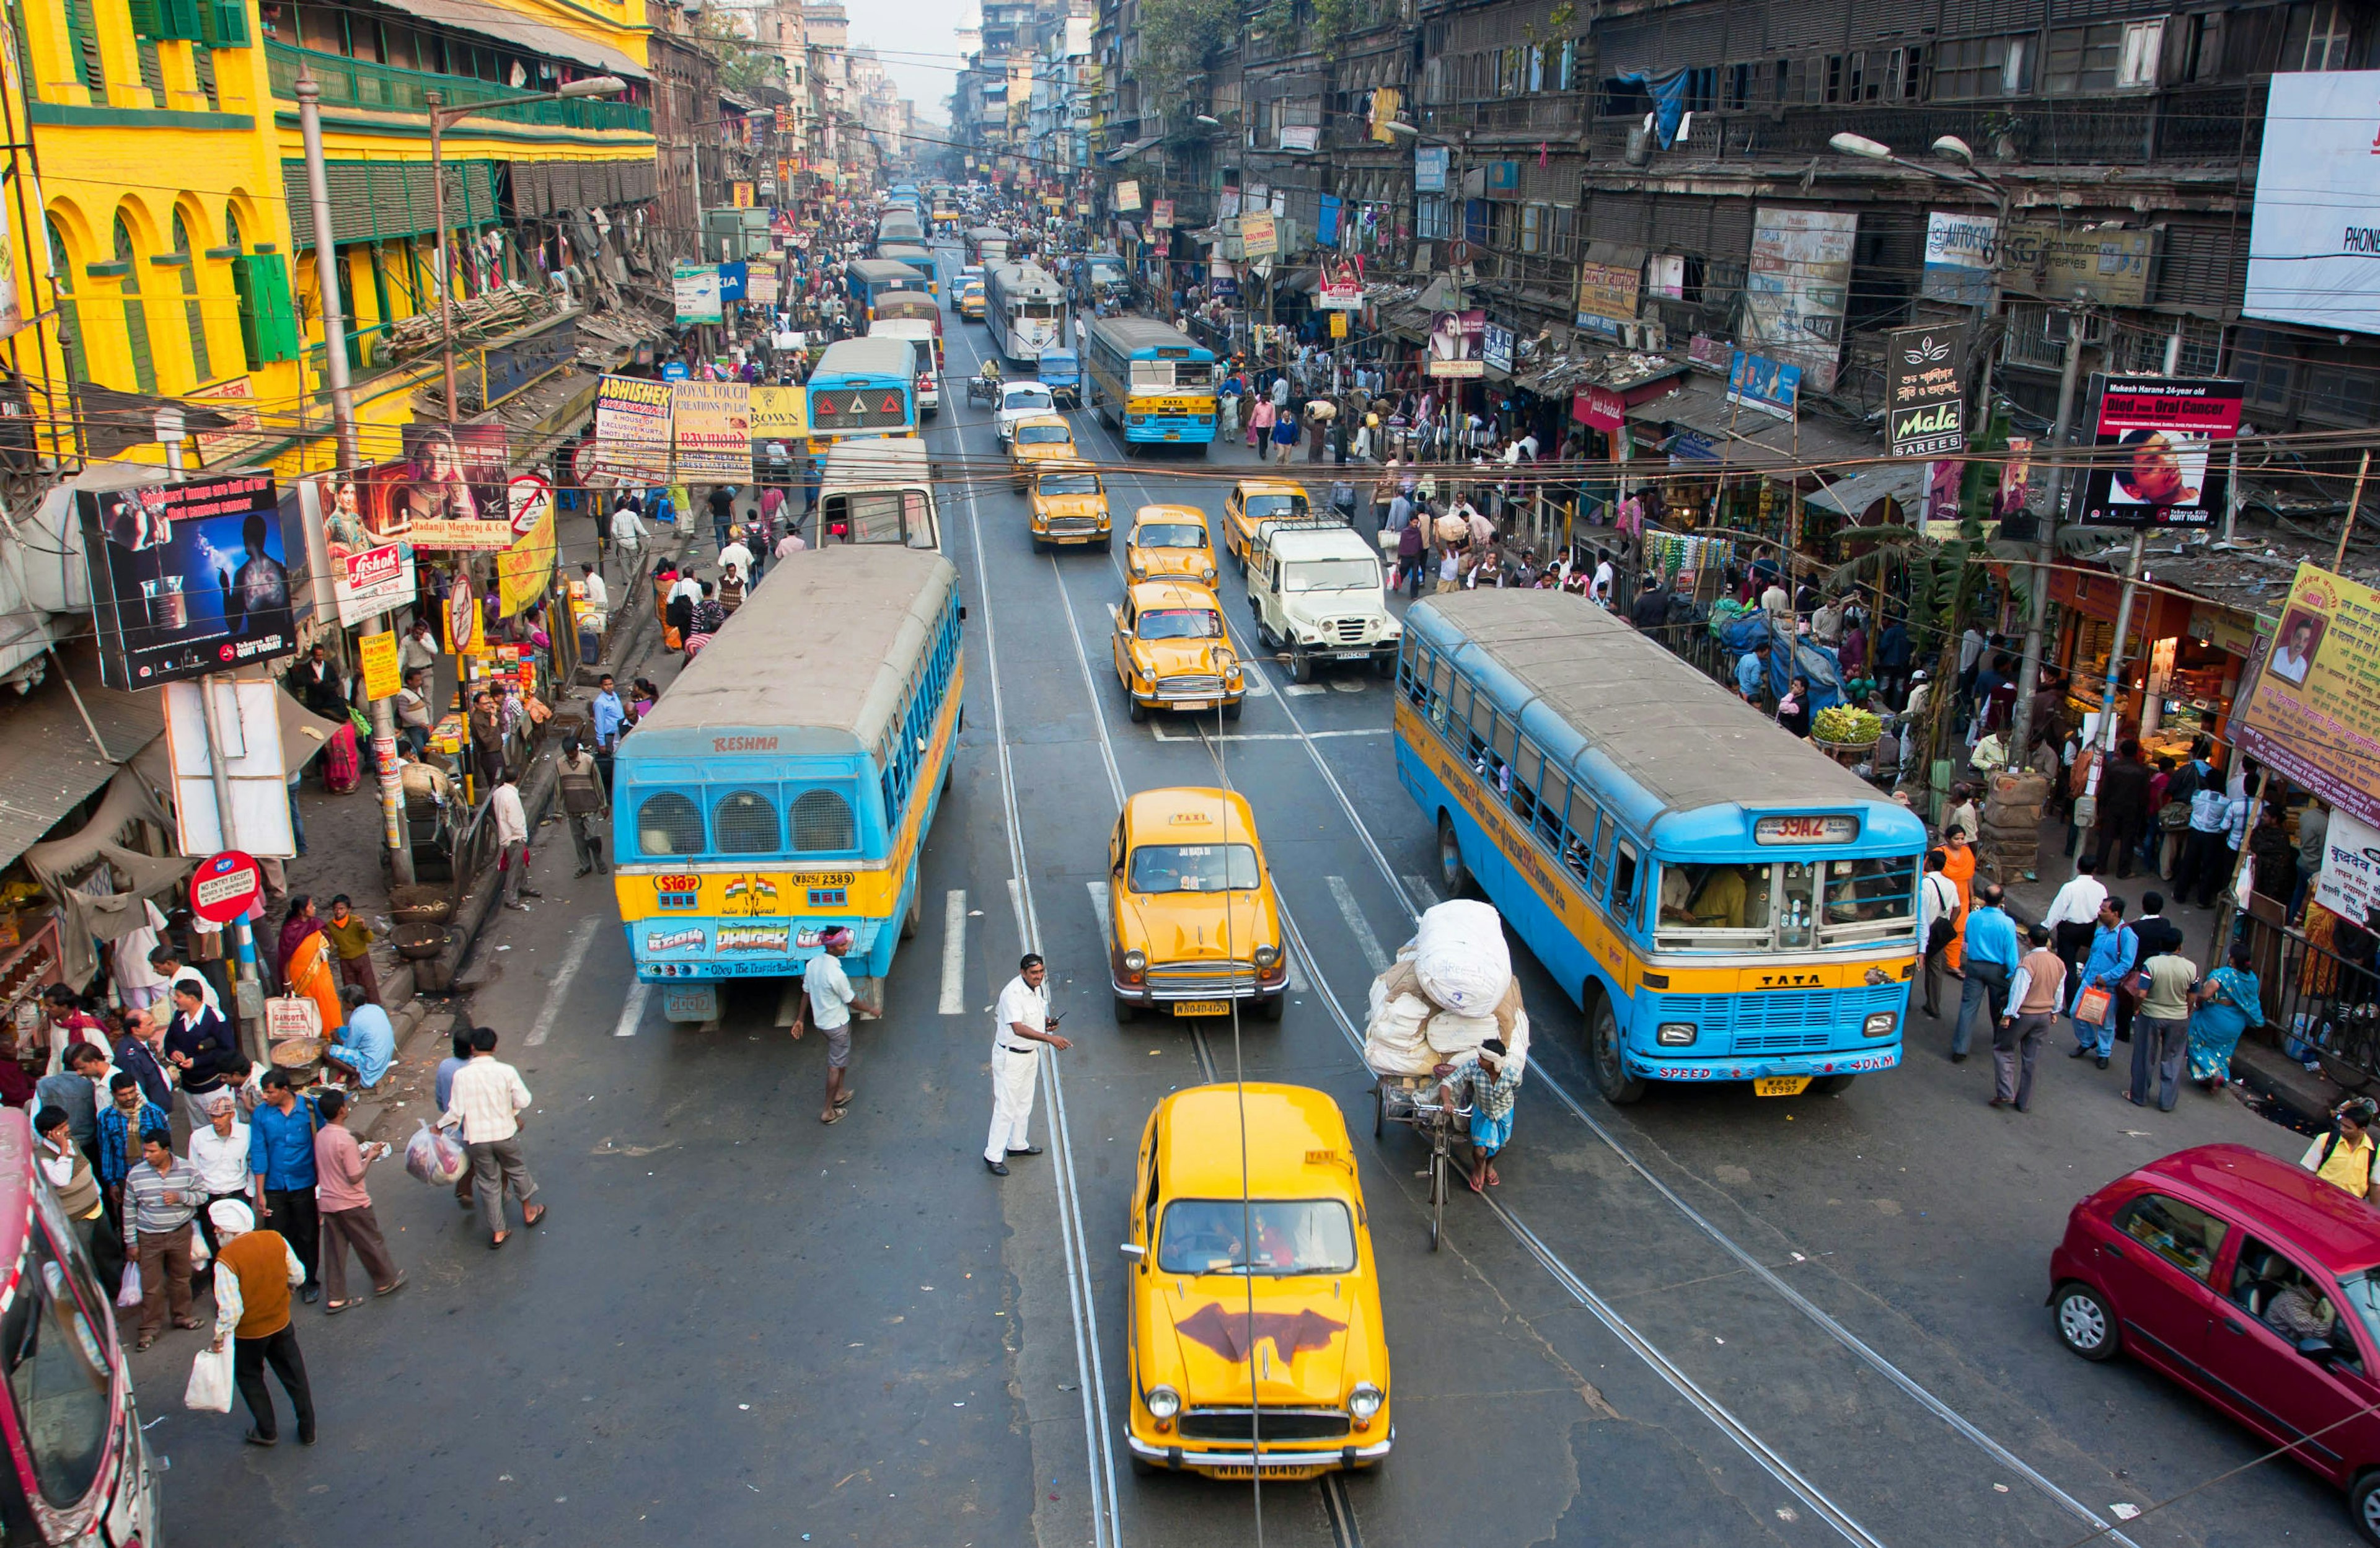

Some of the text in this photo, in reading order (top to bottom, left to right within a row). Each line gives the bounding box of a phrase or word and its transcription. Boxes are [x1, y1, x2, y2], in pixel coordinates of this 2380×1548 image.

[599, 377, 672, 407] ABHISHEK
[676, 384, 747, 400] ROYAL TOUCH
[2109, 384, 2137, 394] Mukesh
[2138, 385, 2164, 394] Harane
[2166, 386, 2192, 397] 24-year
[598, 398, 666, 416] SHERWANI
[676, 400, 720, 411] CREATIONS
[1590, 397, 1620, 420] just baked
[2107, 397, 2135, 412] Died
[2154, 399, 2180, 413] Oral
[2181, 400, 2225, 415] Cancer
[601, 421, 639, 432] EXCLUSIVE
[620, 416, 643, 424] HOUSE
[645, 418, 654, 426] OF
[1897, 404, 1959, 440] Mala
[600, 429, 620, 438] DHOTI
[1895, 437, 1959, 457] SAREES
[185, 486, 212, 500] lungs
[212, 483, 228, 496] are
[228, 479, 244, 495] full
[244, 478, 255, 492] of
[254, 478, 268, 491] tar
[166, 498, 253, 521] that causes cancer
[2186, 514, 2208, 522] TODAY
[410, 521, 509, 533] Madanji Meghraj & Co.
[350, 549, 396, 584] Ashok
[237, 639, 283, 658] QUIT TODAY
[713, 736, 778, 752] RESHMA
[2321, 790, 2345, 809] CHARGES
[2345, 804, 2357, 816] FOR
[1177, 814, 1205, 822] TAXI
[1189, 847, 1204, 856] MATA
[211, 877, 229, 889] ENTRY
[230, 871, 251, 882] EXCEPT
[661, 875, 697, 892] STOP
[822, 874, 850, 885] 2389
[710, 964, 732, 976] Obey
[734, 963, 749, 975] The
[751, 962, 777, 974] Traffic
[1762, 975, 1820, 985] TATA
[1659, 1067, 1711, 1079] SPEED
[1308, 1150, 1336, 1163] TAXI
